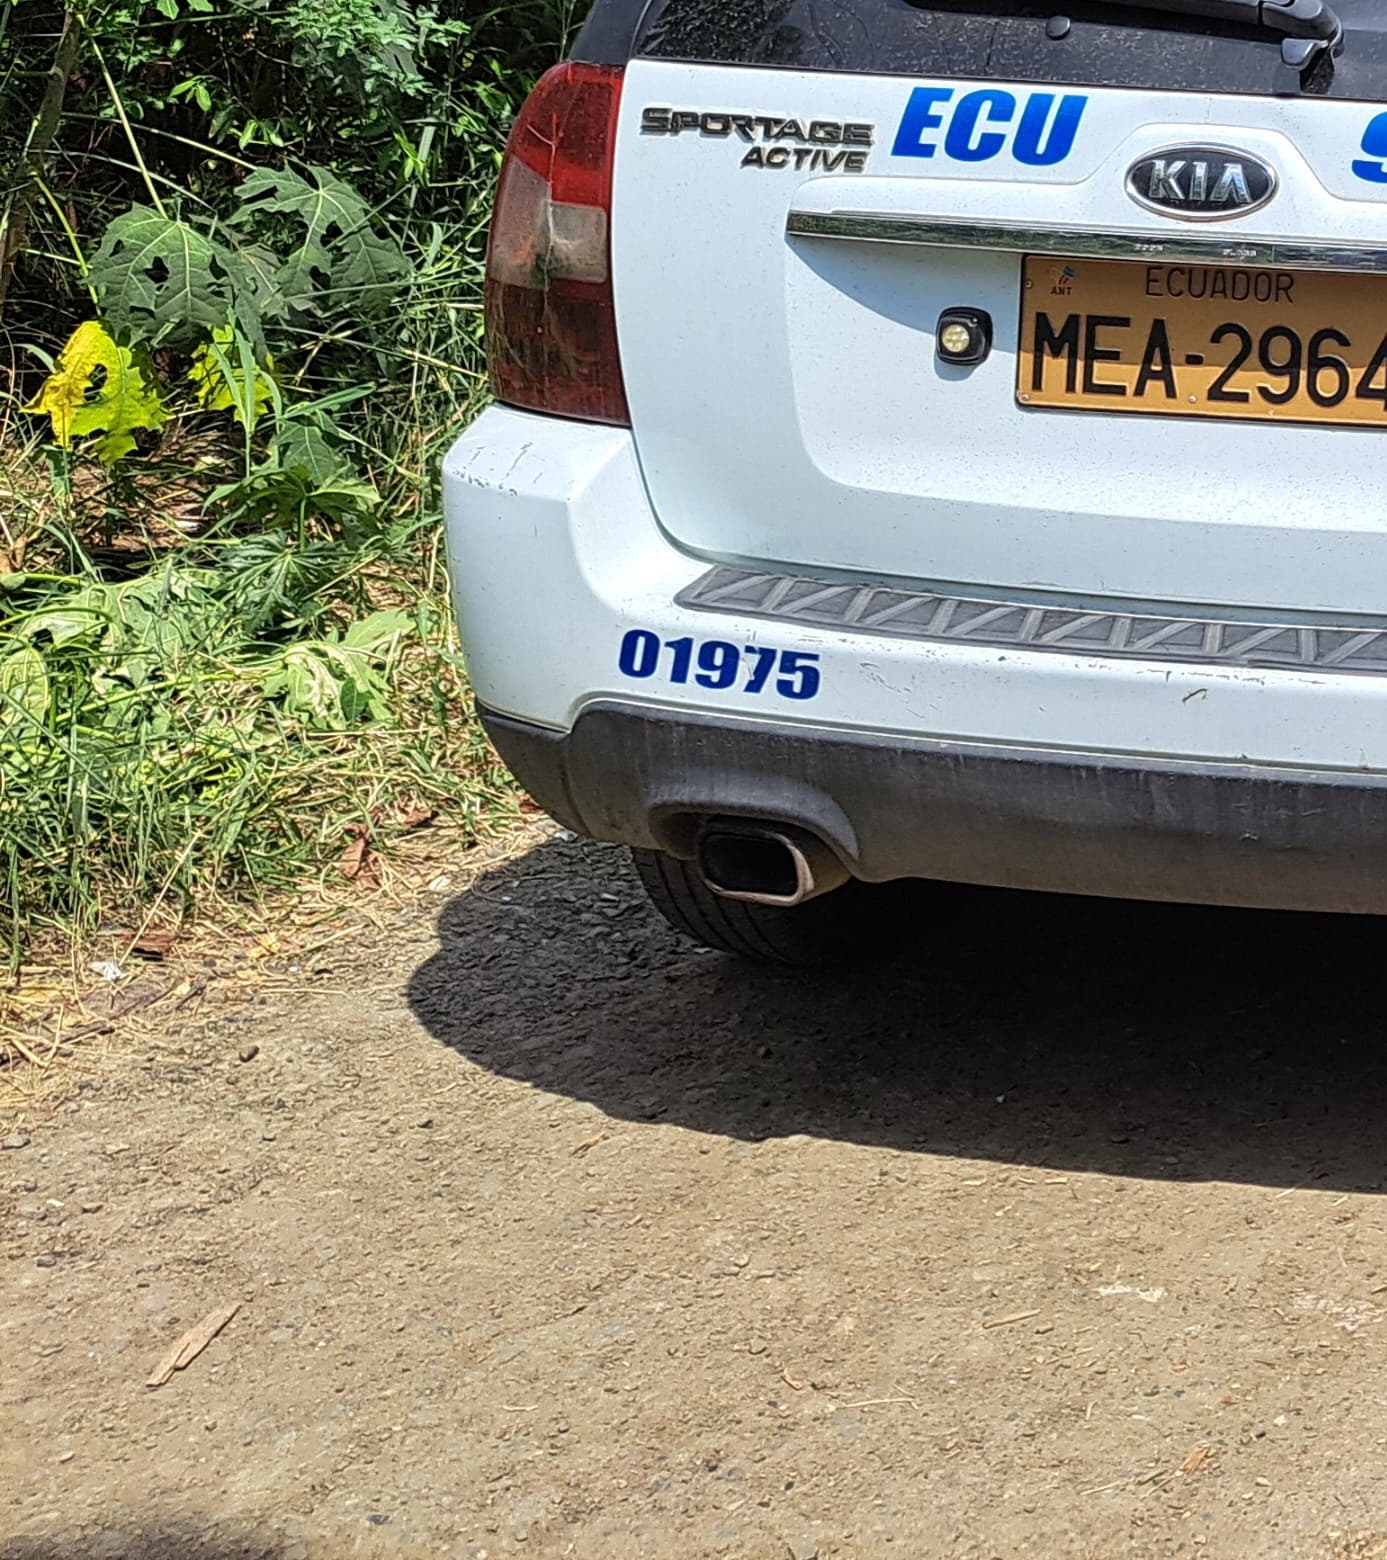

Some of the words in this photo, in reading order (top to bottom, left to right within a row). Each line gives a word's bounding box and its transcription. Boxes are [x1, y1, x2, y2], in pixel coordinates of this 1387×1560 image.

[640, 107, 875, 145] SPORTAGE
[891, 86, 1088, 166] ECU
[739, 146, 868, 172] ACTIVE
[1149, 159, 1253, 204] KIA
[1050, 286, 1073, 296] ANT
[1145, 266, 1295, 304] ECUADOR
[617, 628, 822, 701] 01975
